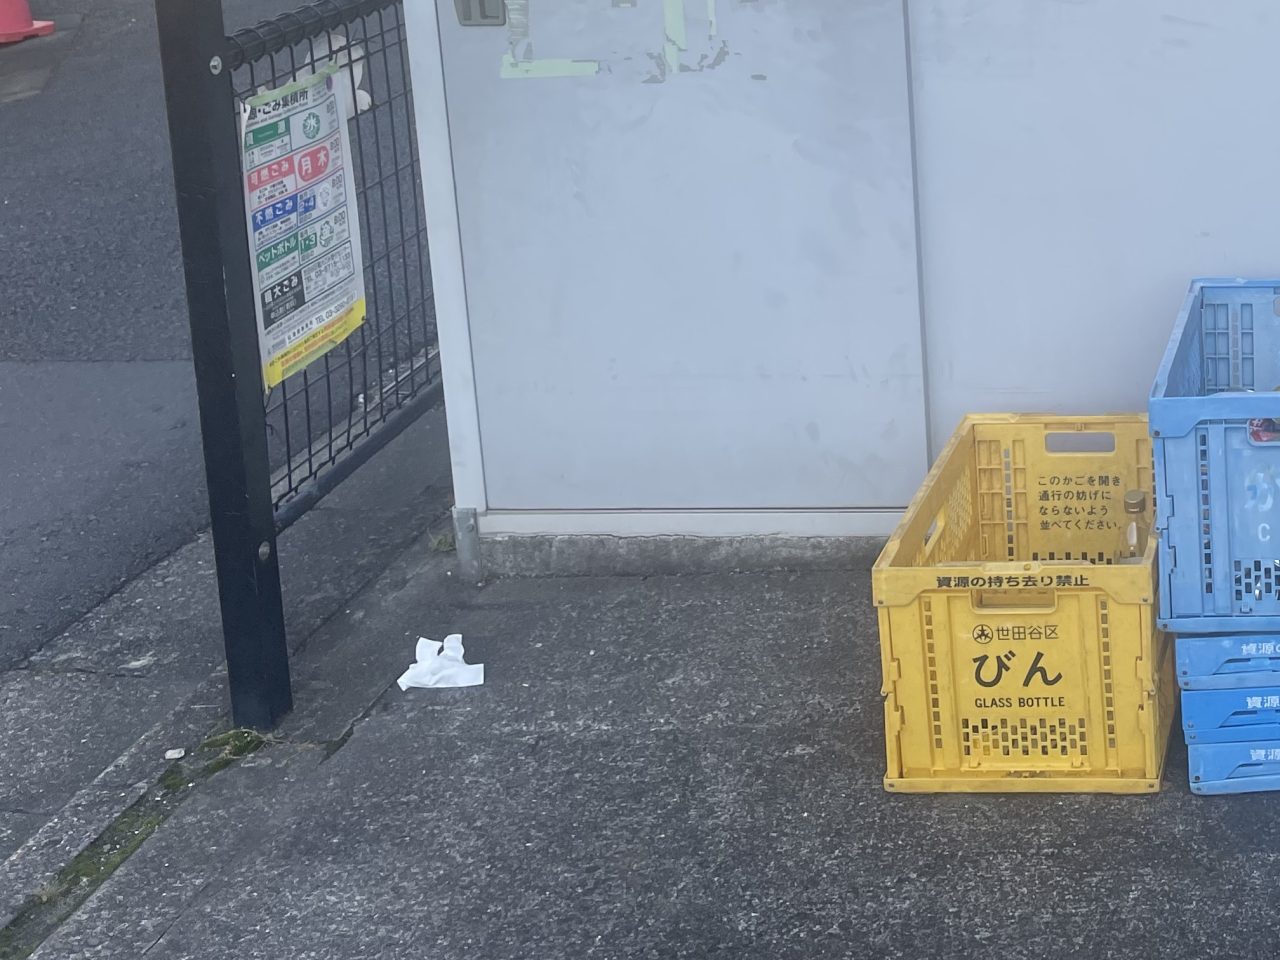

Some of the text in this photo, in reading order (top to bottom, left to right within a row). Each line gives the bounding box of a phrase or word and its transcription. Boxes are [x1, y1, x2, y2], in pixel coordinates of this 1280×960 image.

[258, 236, 297, 263] ペットボトル
[1038, 475, 1121, 486] このかごを開き
[1038, 490, 1112, 501] 通行の妨げに
[1039, 505, 1108, 516] ならないよう
[936, 574, 1090, 588] 資源の持ち去り禁止
[994, 624, 1060, 641] 世田谷区
[972, 650, 1063, 688] びん
[974, 696, 1065, 709] GLASS BOTTLE
